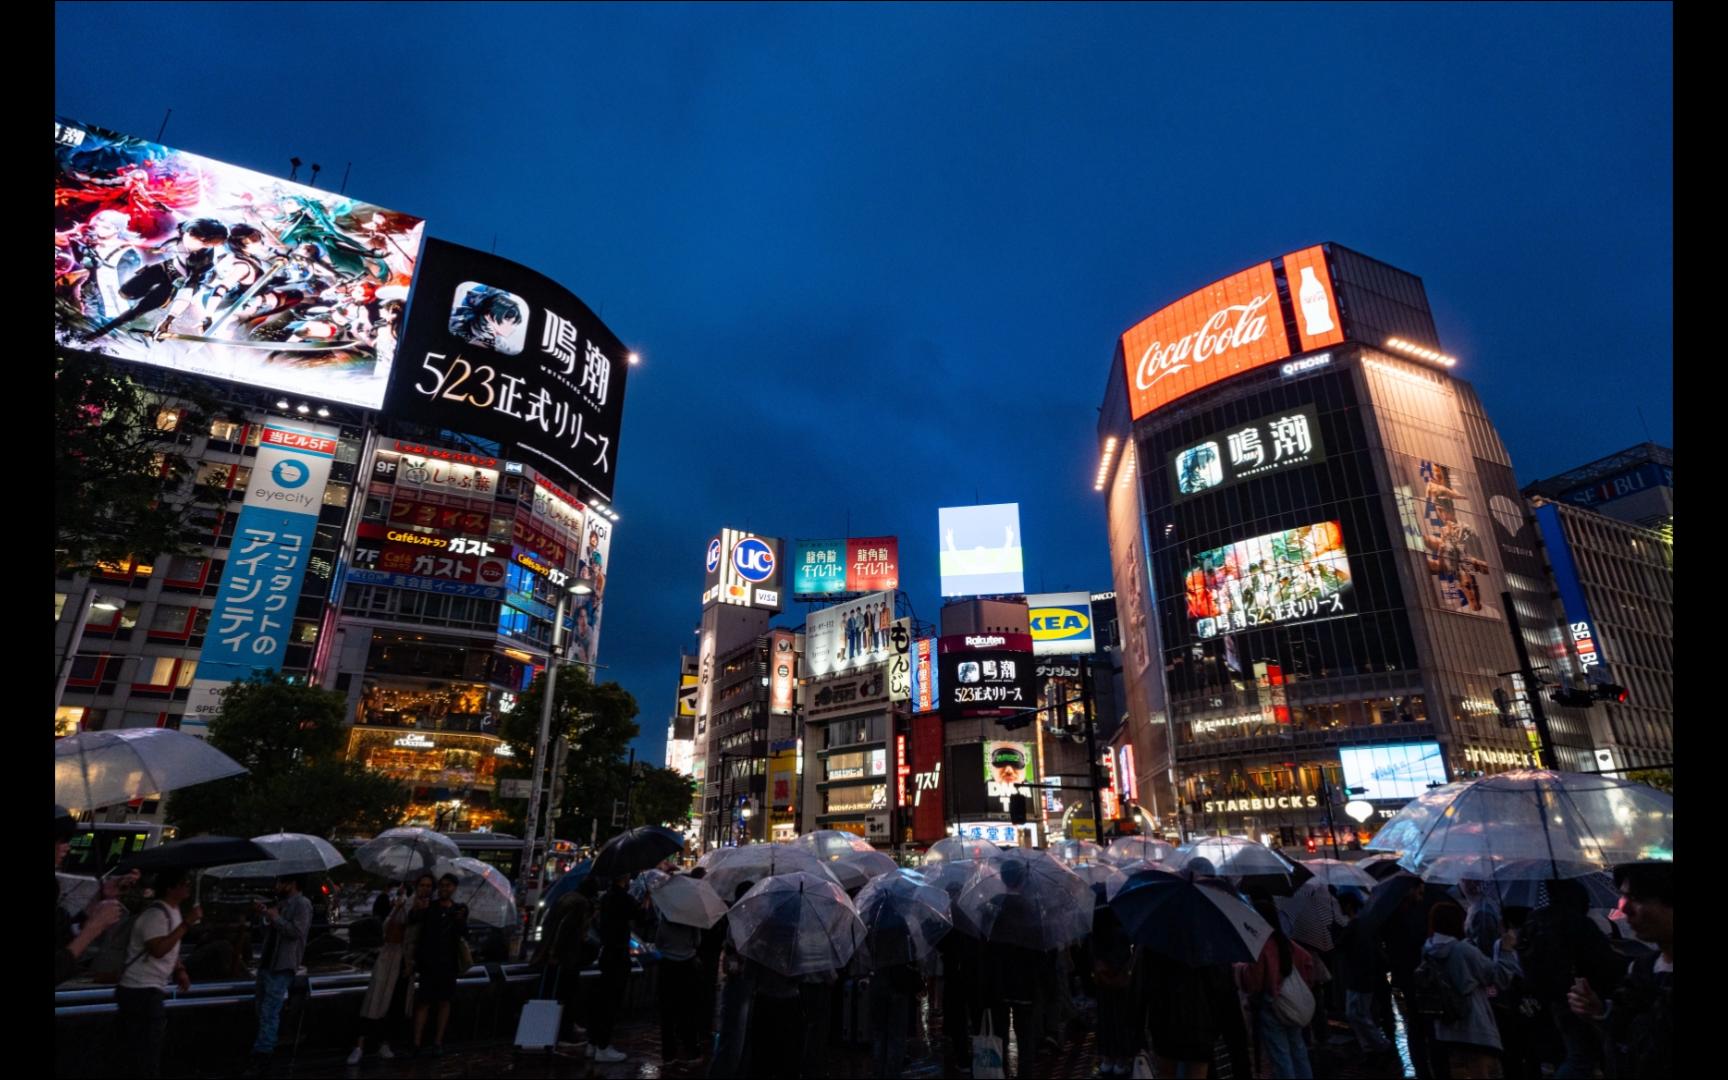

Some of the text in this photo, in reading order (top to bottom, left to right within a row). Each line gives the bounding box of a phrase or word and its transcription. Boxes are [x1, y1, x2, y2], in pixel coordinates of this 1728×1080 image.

[1136, 292, 1273, 390] Coca-Cola
[541, 307, 611, 406] 鳴潮
[415, 351, 609, 474] 5/23正式リリース
[268, 431, 329, 451] 当ビル5F
[1226, 413, 1312, 468] 鳴潮
[375, 460, 397, 474] 9F
[256, 488, 314, 506] eyecity
[355, 548, 380, 562] 7F
[448, 537, 496, 557] ガスト
[412, 554, 472, 579] ガスト
[736, 546, 773, 572] UC
[218, 528, 277, 653] アイシティ
[253, 534, 303, 656] コンタクトの
[758, 593, 777, 602] VISA
[965, 636, 1006, 648] Rakuten
[891, 621, 910, 697] もんじゃ
[982, 660, 1016, 680] 鳴潮
[955, 686, 1023, 703] 5/23正式リリース
[914, 762, 942, 807] クスリ
[1205, 795, 1318, 813] STARBUCKS
